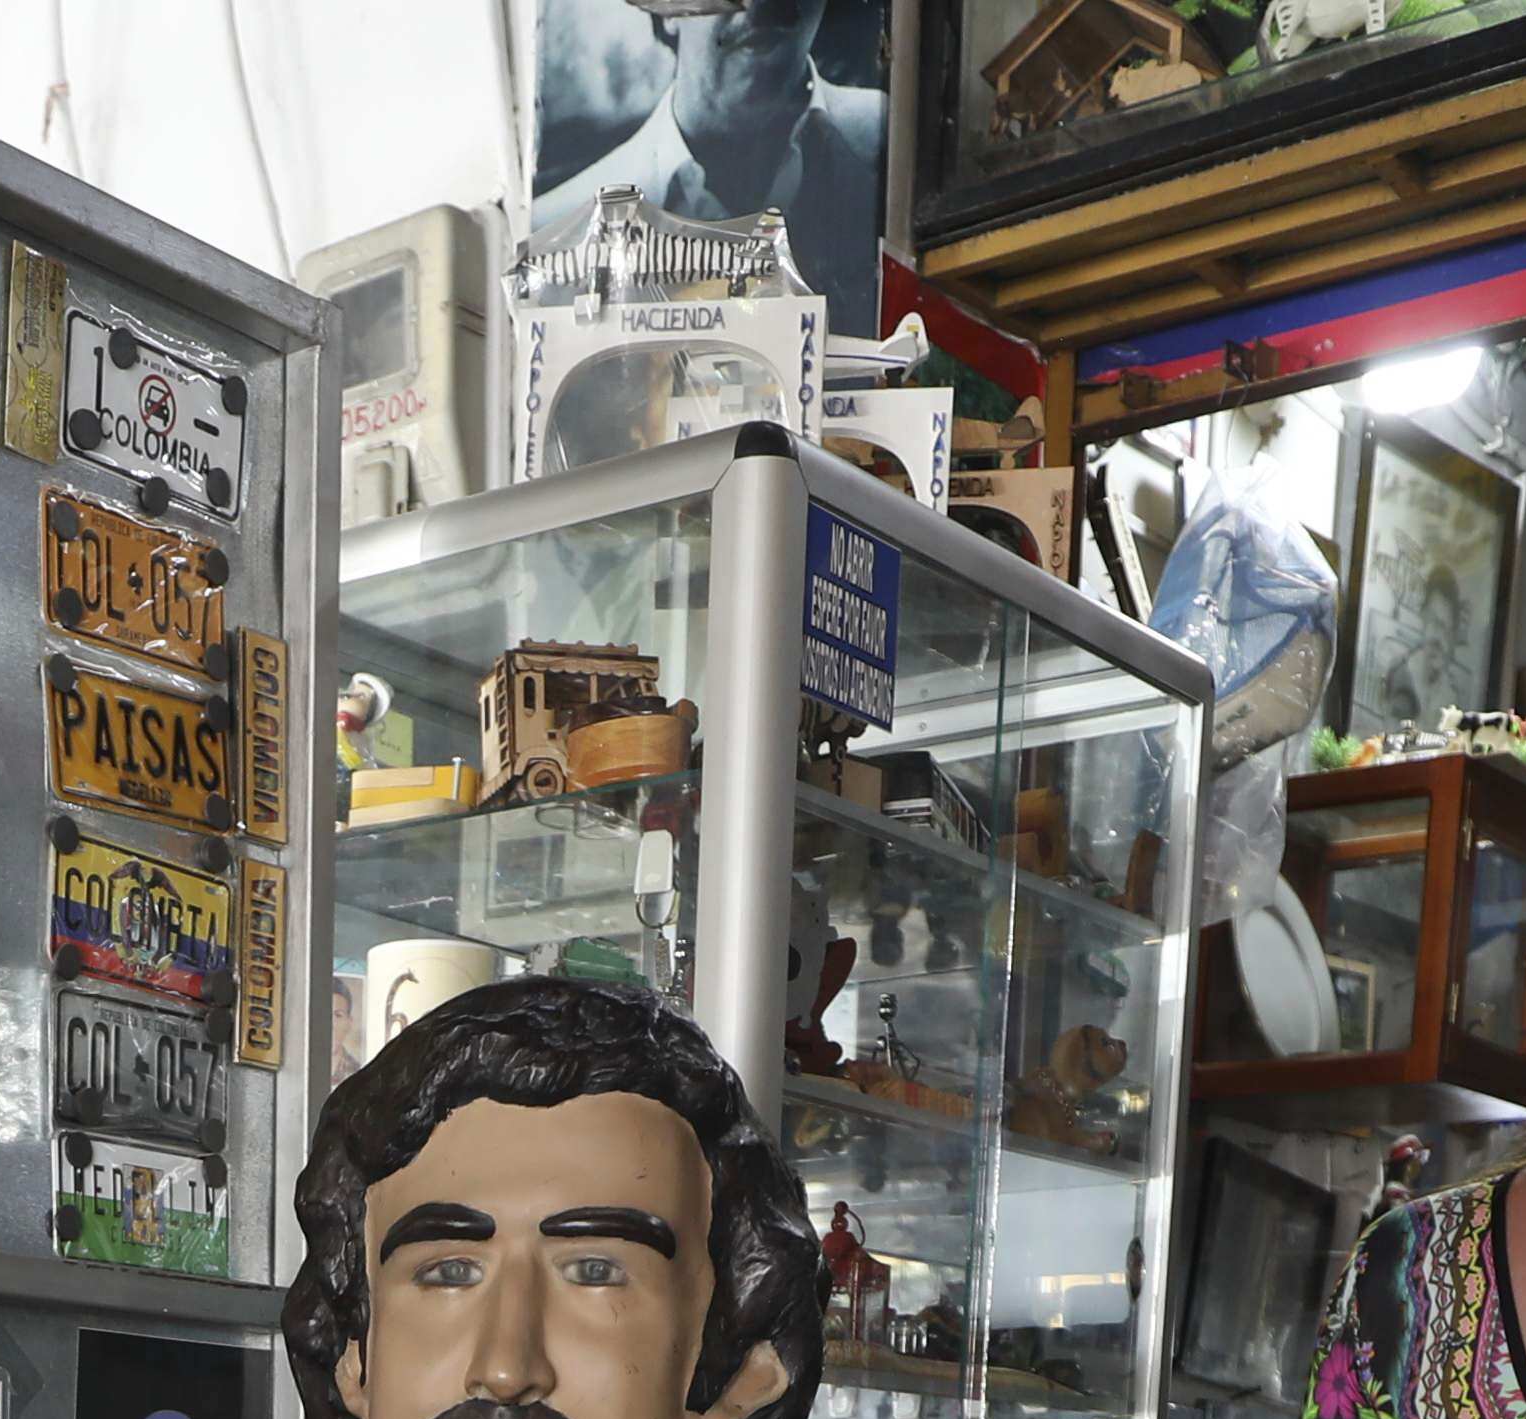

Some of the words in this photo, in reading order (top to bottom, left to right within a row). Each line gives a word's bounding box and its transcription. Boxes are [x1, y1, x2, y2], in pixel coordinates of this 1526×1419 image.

[621, 306, 725, 332] HACIENDA
[96, 407, 215, 482] COLOMBIA
[829, 522, 845, 573] NO
[846, 529, 875, 594] ABRIR
[811, 573, 842, 638] ESPERE
[844, 590, 863, 644] POR
[862, 597, 887, 659] FAVOR
[59, 691, 222, 793] PAISAS
[252, 646, 281, 825] COLOMBIA
[247, 879, 278, 1051] COLOMBIA
[64, 1015, 132, 1104] COL
[154, 1034, 219, 1115] 057
